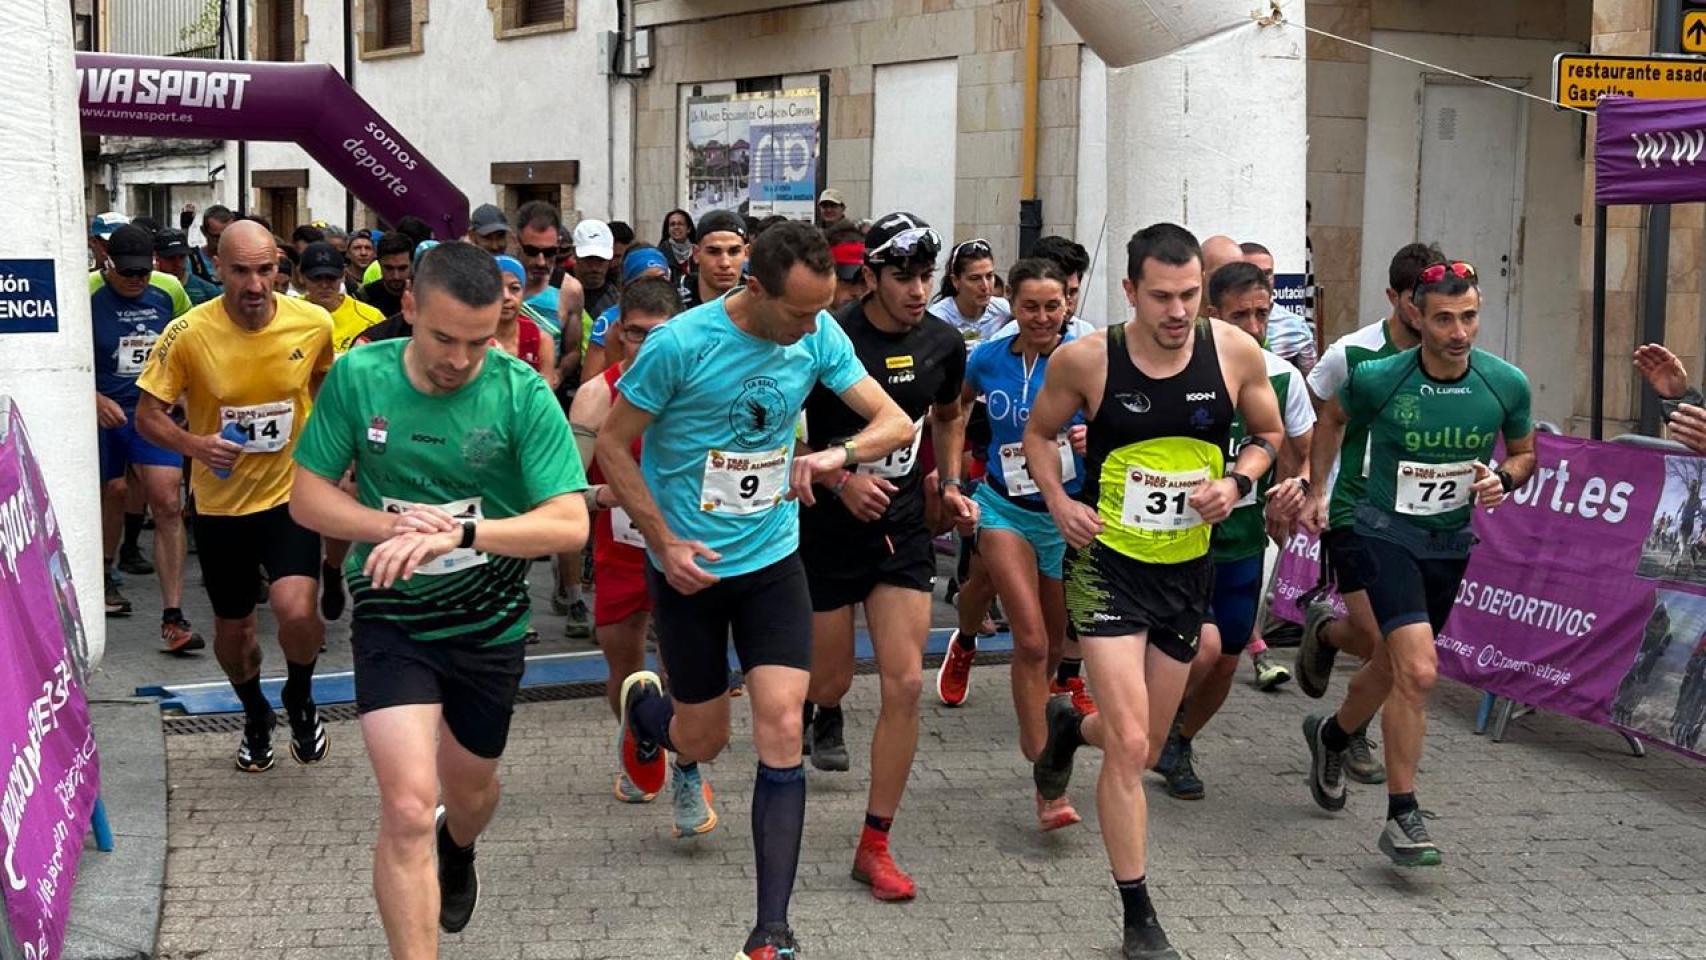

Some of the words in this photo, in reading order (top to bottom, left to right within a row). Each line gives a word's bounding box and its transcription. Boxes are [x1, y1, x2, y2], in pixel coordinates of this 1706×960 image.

[1568, 62, 1661, 81] restaurante
[80, 107, 193, 123] ww.runvasport.es
[364, 122, 418, 170] somos
[1631, 129, 1706, 169] ww
[343, 138, 408, 196] deporte
[248, 420, 280, 440] 14
[739, 475, 759, 499] 9
[1418, 480, 1457, 502] 72
[1502, 459, 1635, 524] ort.es
[1145, 491, 1186, 515] 31
[1477, 585, 1597, 637] DEPORTIVOS
